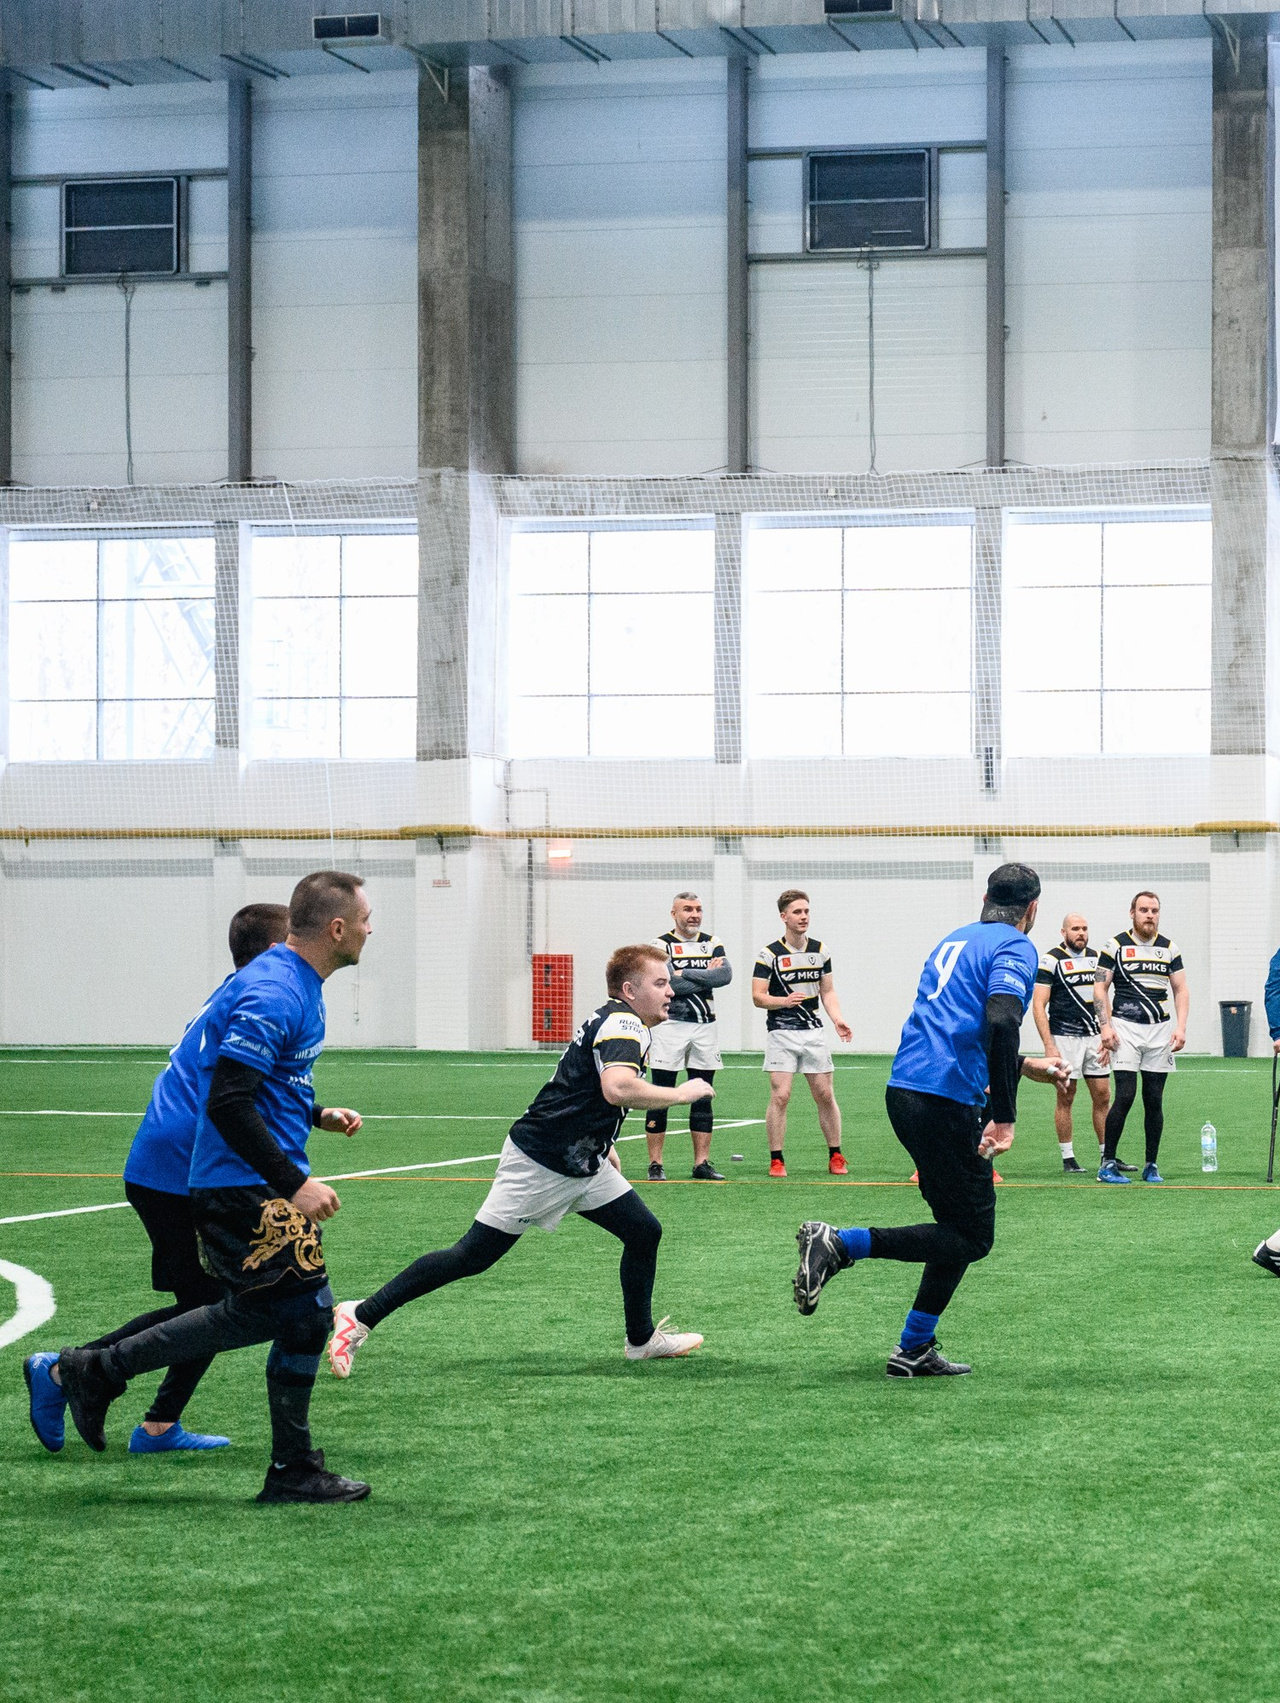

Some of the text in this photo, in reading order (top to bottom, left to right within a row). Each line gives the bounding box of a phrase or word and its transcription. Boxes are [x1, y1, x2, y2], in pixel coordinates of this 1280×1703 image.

[926, 940, 969, 1002] 9
[1142, 962, 1167, 973] МКБ
[797, 970, 821, 980] МКБ
